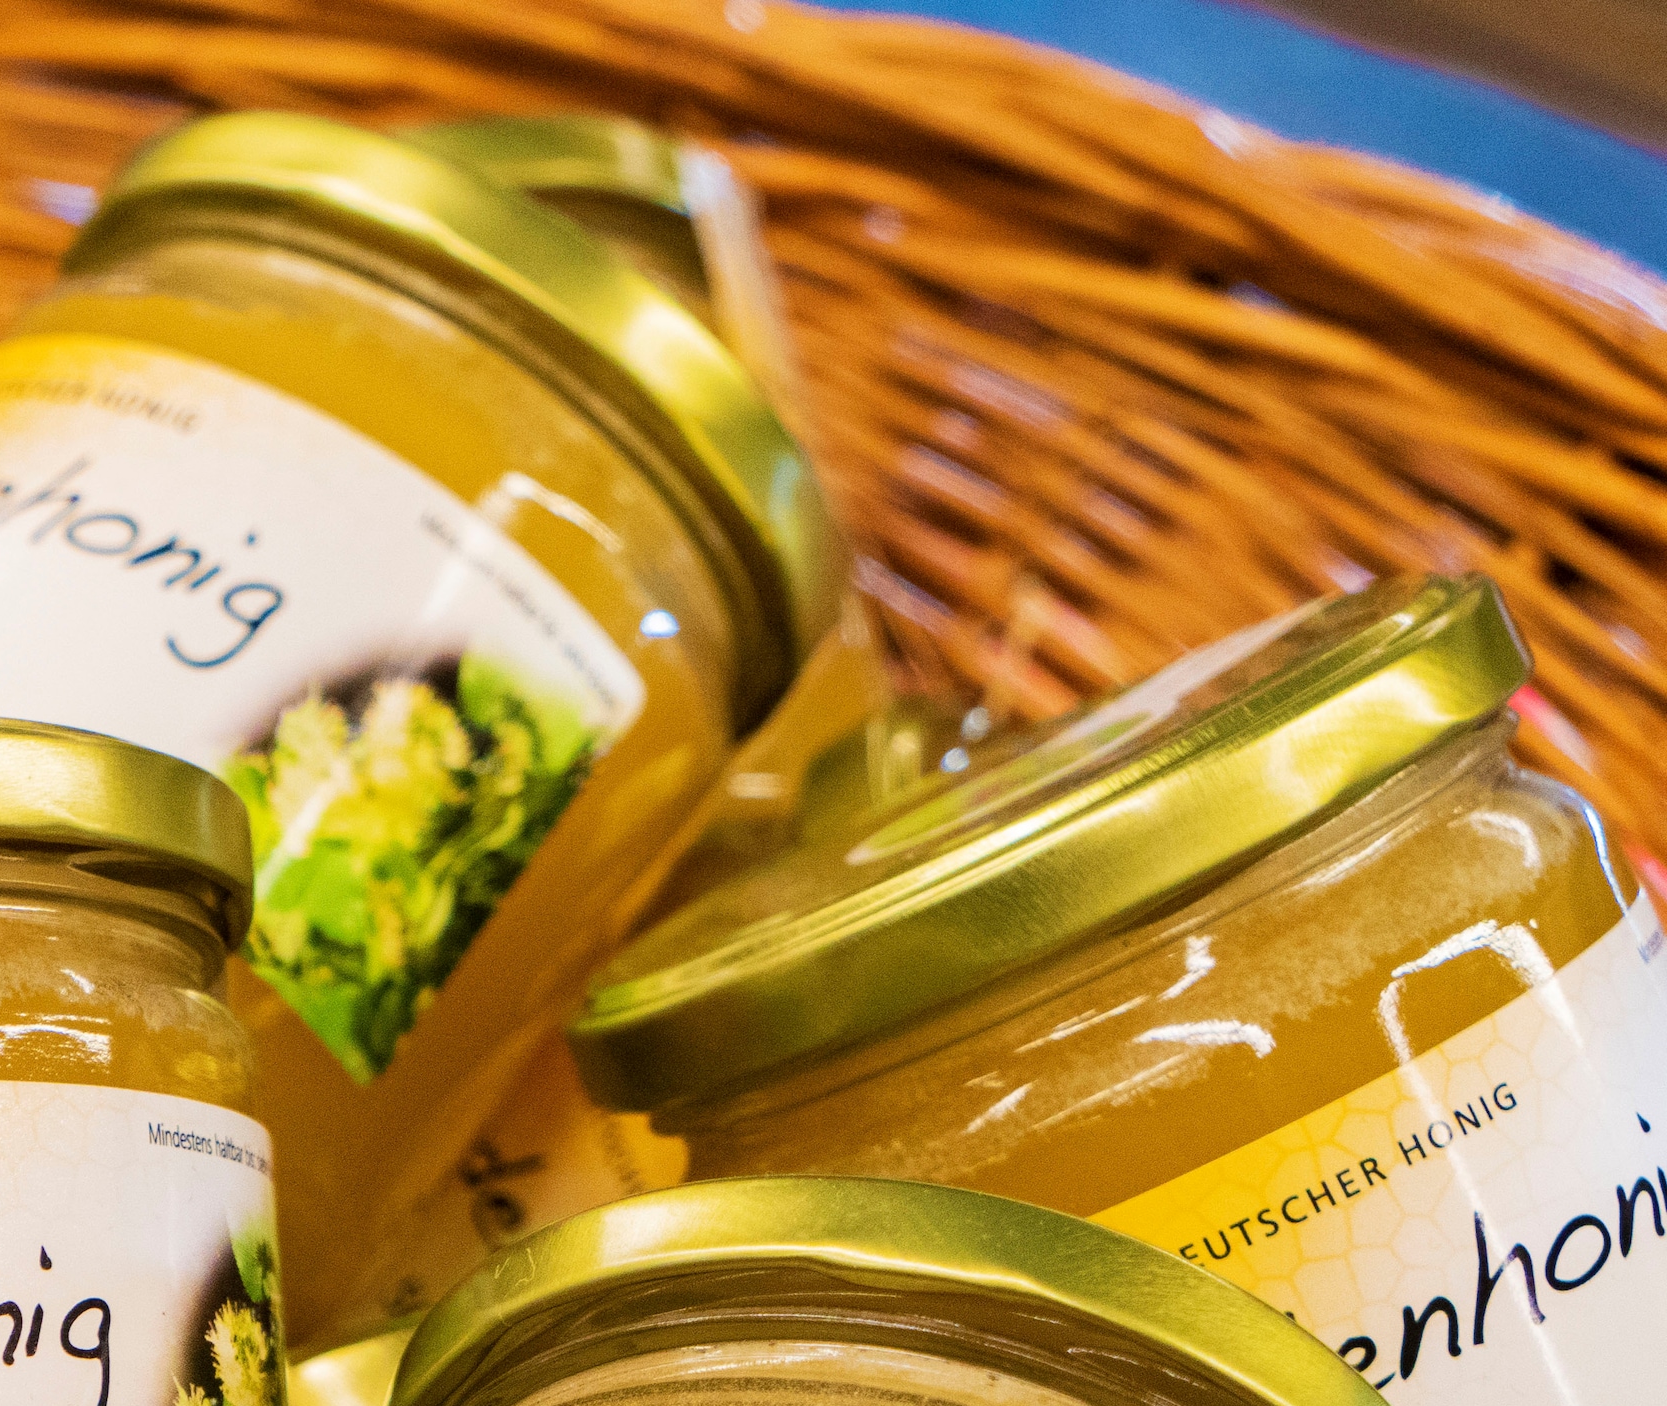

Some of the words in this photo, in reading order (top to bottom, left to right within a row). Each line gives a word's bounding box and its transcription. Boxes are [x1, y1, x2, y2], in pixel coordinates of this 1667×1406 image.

[149, 1122, 212, 1155] Mindestens
[1178, 1155, 1387, 1270] EUTSCHER
[1398, 1081, 1519, 1166] HONIG
[1285, 1110, 1667, 1391] enhoni
